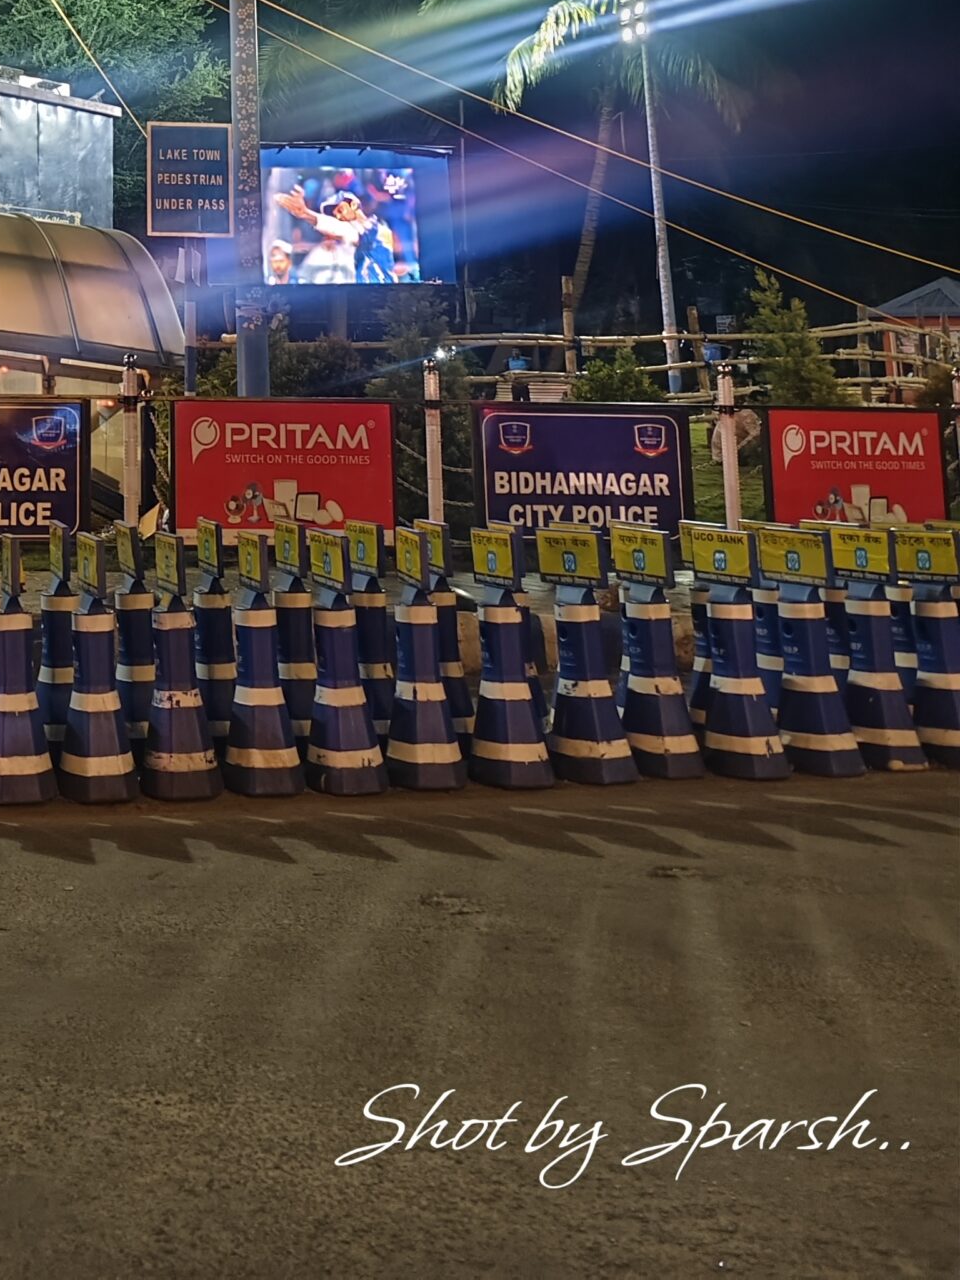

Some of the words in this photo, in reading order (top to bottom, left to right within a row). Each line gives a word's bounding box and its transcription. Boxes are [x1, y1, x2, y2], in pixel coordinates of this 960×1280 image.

[159, 149, 188, 161] LAKE
[193, 149, 221, 161] TOWN
[157, 173, 223, 186] PEDESTRIAN
[155, 198, 193, 210] UNDER
[197, 199, 225, 210] PASS
[225, 423, 369, 449] PRITAM
[810, 430, 925, 456] PRITAM
[225, 454, 264, 465] SWITCH
[266, 454, 282, 465] ON
[286, 454, 303, 465] THE
[306, 454, 337, 465] GOOD
[339, 454, 370, 465] TIMES
[811, 460, 840, 470] SWITCH
[843, 460, 855, 470] ON
[858, 460, 873, 470] THE
[875, 460, 899, 470] GOOD
[901, 460, 925, 470] TIMES
[495, 471, 670, 496] BIDHANNAGAR
[508, 504, 564, 527] CITY
[572, 504, 658, 528] POLICE
[693, 532, 715, 542] UCO
[717, 534, 745, 545] BANK
